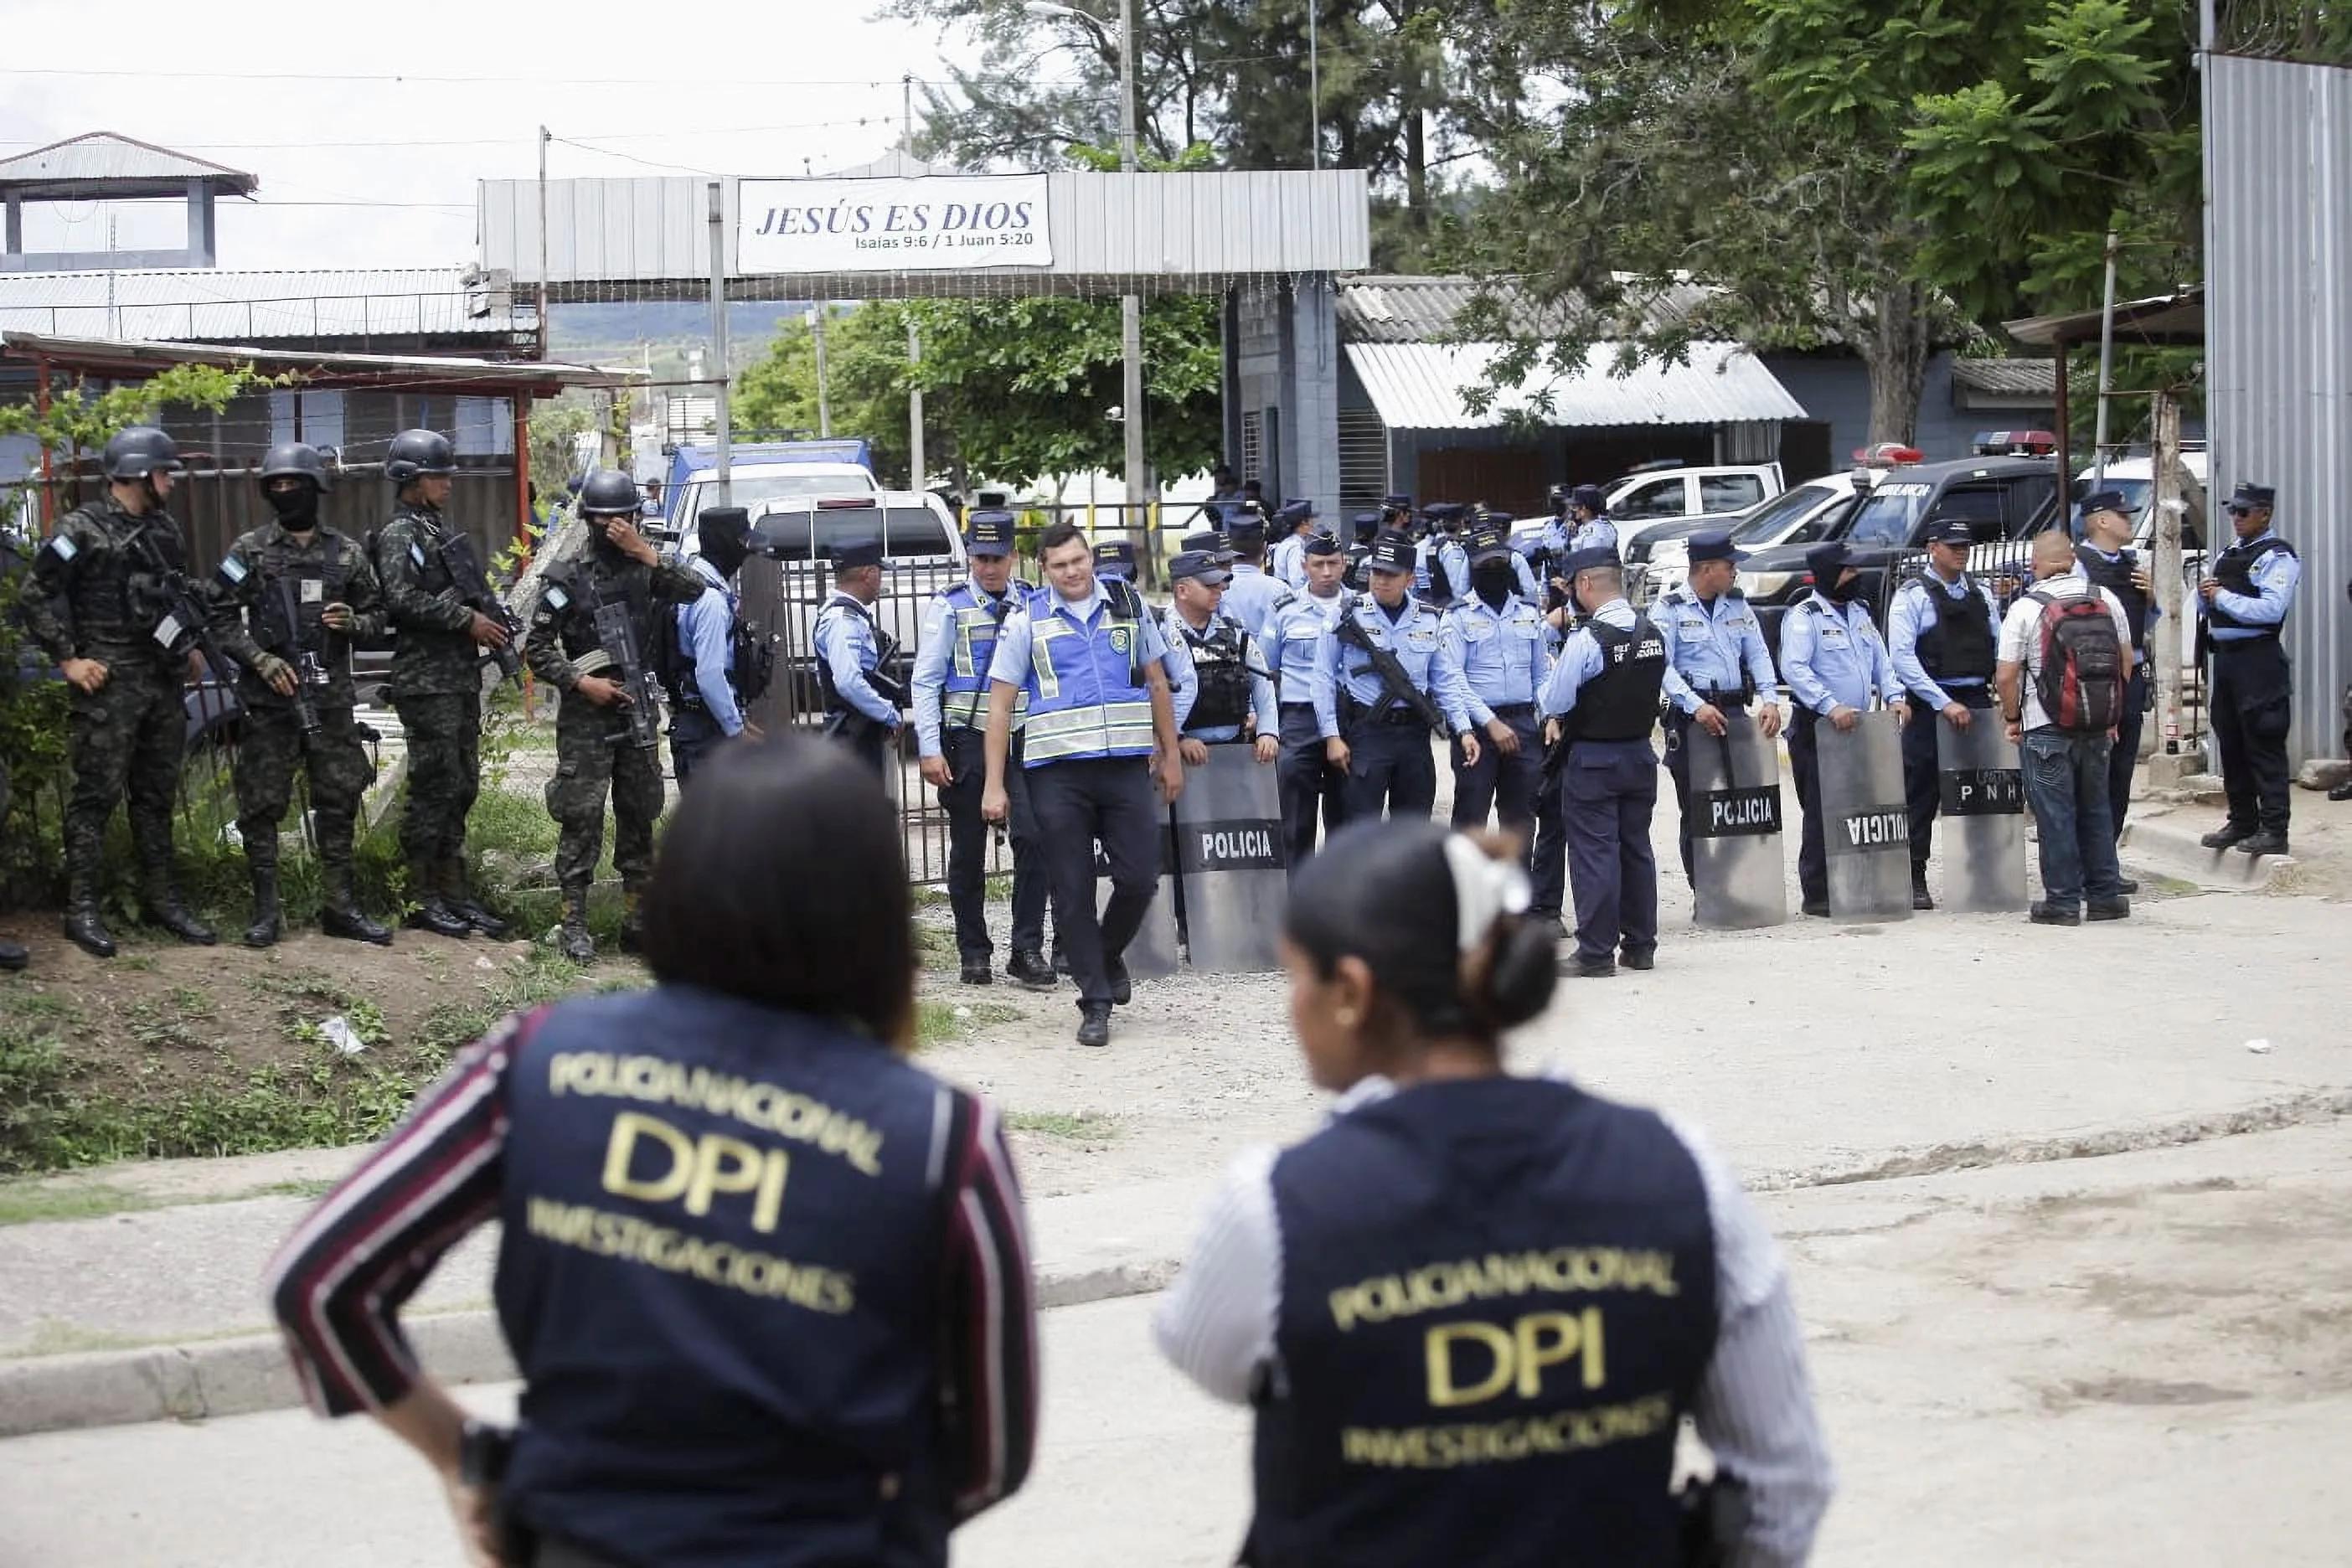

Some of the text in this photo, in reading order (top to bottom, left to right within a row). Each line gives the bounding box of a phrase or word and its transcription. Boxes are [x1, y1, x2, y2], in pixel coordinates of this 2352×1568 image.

[756, 199, 1033, 235] JESÚS ES DIOS
[904, 236, 927, 247] 9:6
[944, 235, 954, 246] 1
[957, 234, 994, 246] Juan
[999, 233, 1033, 245] 5:20
[1201, 830, 1272, 859] POLICIA
[1712, 797, 1773, 827] POLICIA
[549, 1051, 884, 1177] POLICIA NACIONAL
[601, 1111, 790, 1233] DPI
[527, 1196, 855, 1315] INVESTIGACIONES
[1328, 1246, 1679, 1332] POLICIA NACIONAL
[1426, 1304, 1606, 1407] DPI
[1342, 1390, 1671, 1469] INVESTIGACIONES
